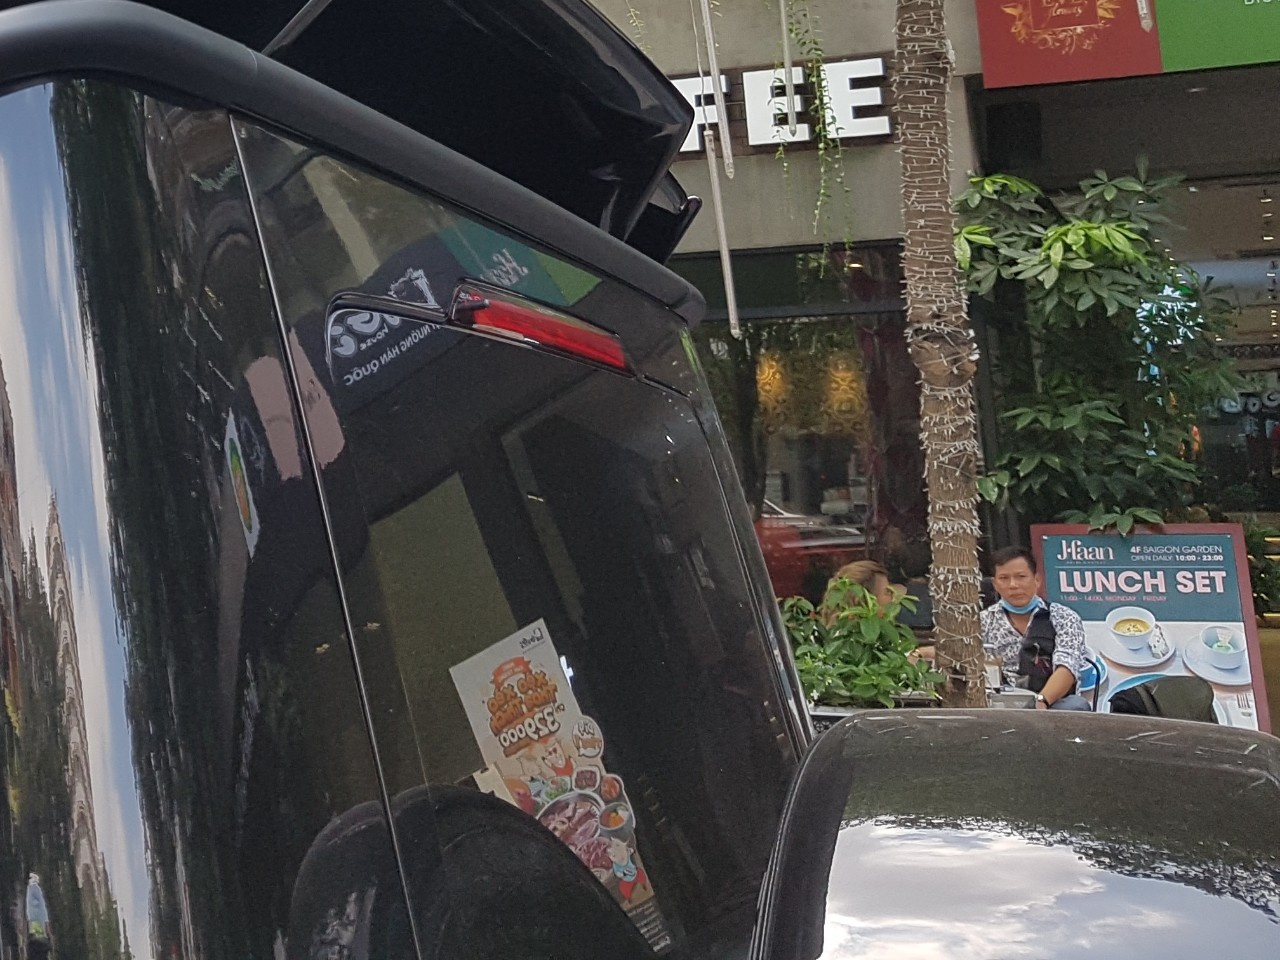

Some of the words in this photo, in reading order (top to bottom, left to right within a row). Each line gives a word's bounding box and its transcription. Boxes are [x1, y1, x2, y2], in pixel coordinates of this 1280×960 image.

[670, 57, 892, 152] FEE
[1130, 545, 1141, 554] 4F
[1143, 545, 1180, 554] SAIGON
[1181, 545, 1223, 554] GARDEN
[1058, 570, 1167, 593] LUNCH
[1175, 570, 1227, 593] SET
